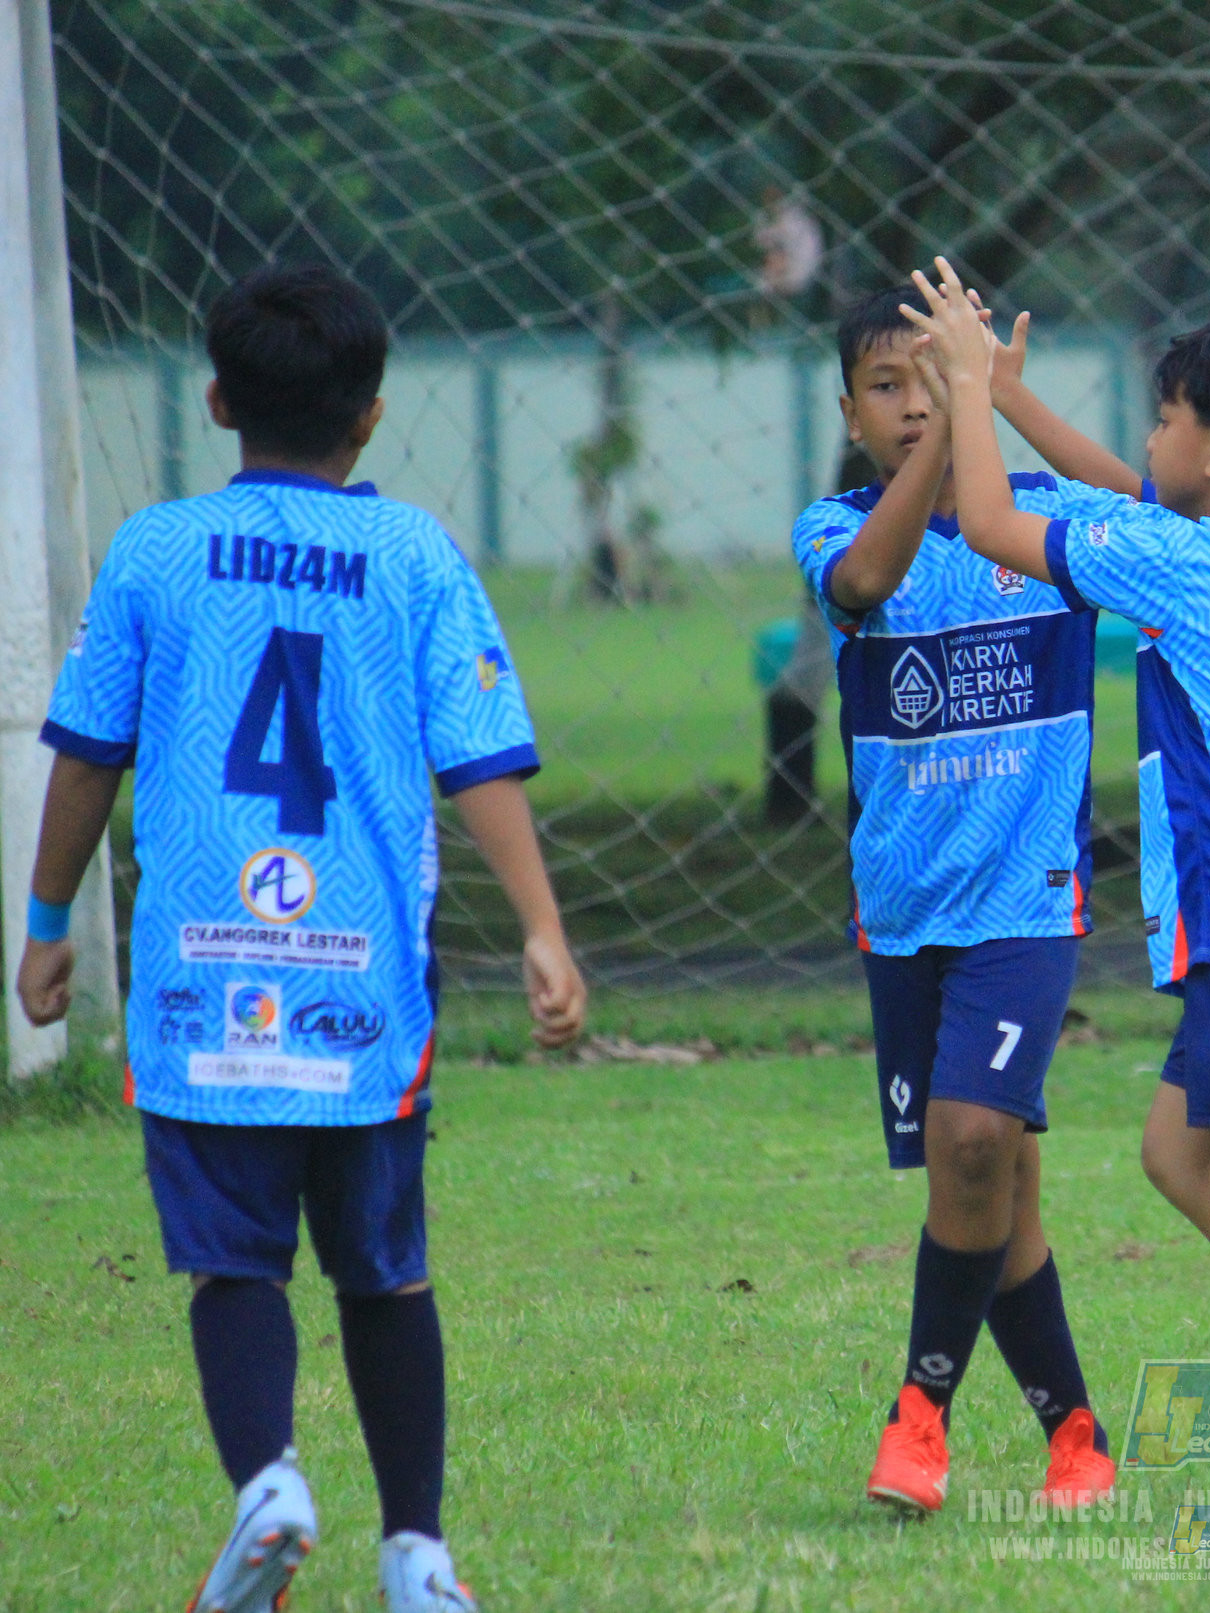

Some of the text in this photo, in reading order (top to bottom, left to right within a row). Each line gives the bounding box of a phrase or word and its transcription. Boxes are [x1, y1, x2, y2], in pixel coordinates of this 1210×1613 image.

[951, 642, 1019, 672] KARYA
[950, 664, 1033, 698] BERKAH
[221, 626, 338, 836] 4
[297, 933, 367, 951] LESTARI
[228, 1032, 277, 1045] RAN
[989, 1020, 1023, 1071] 7
